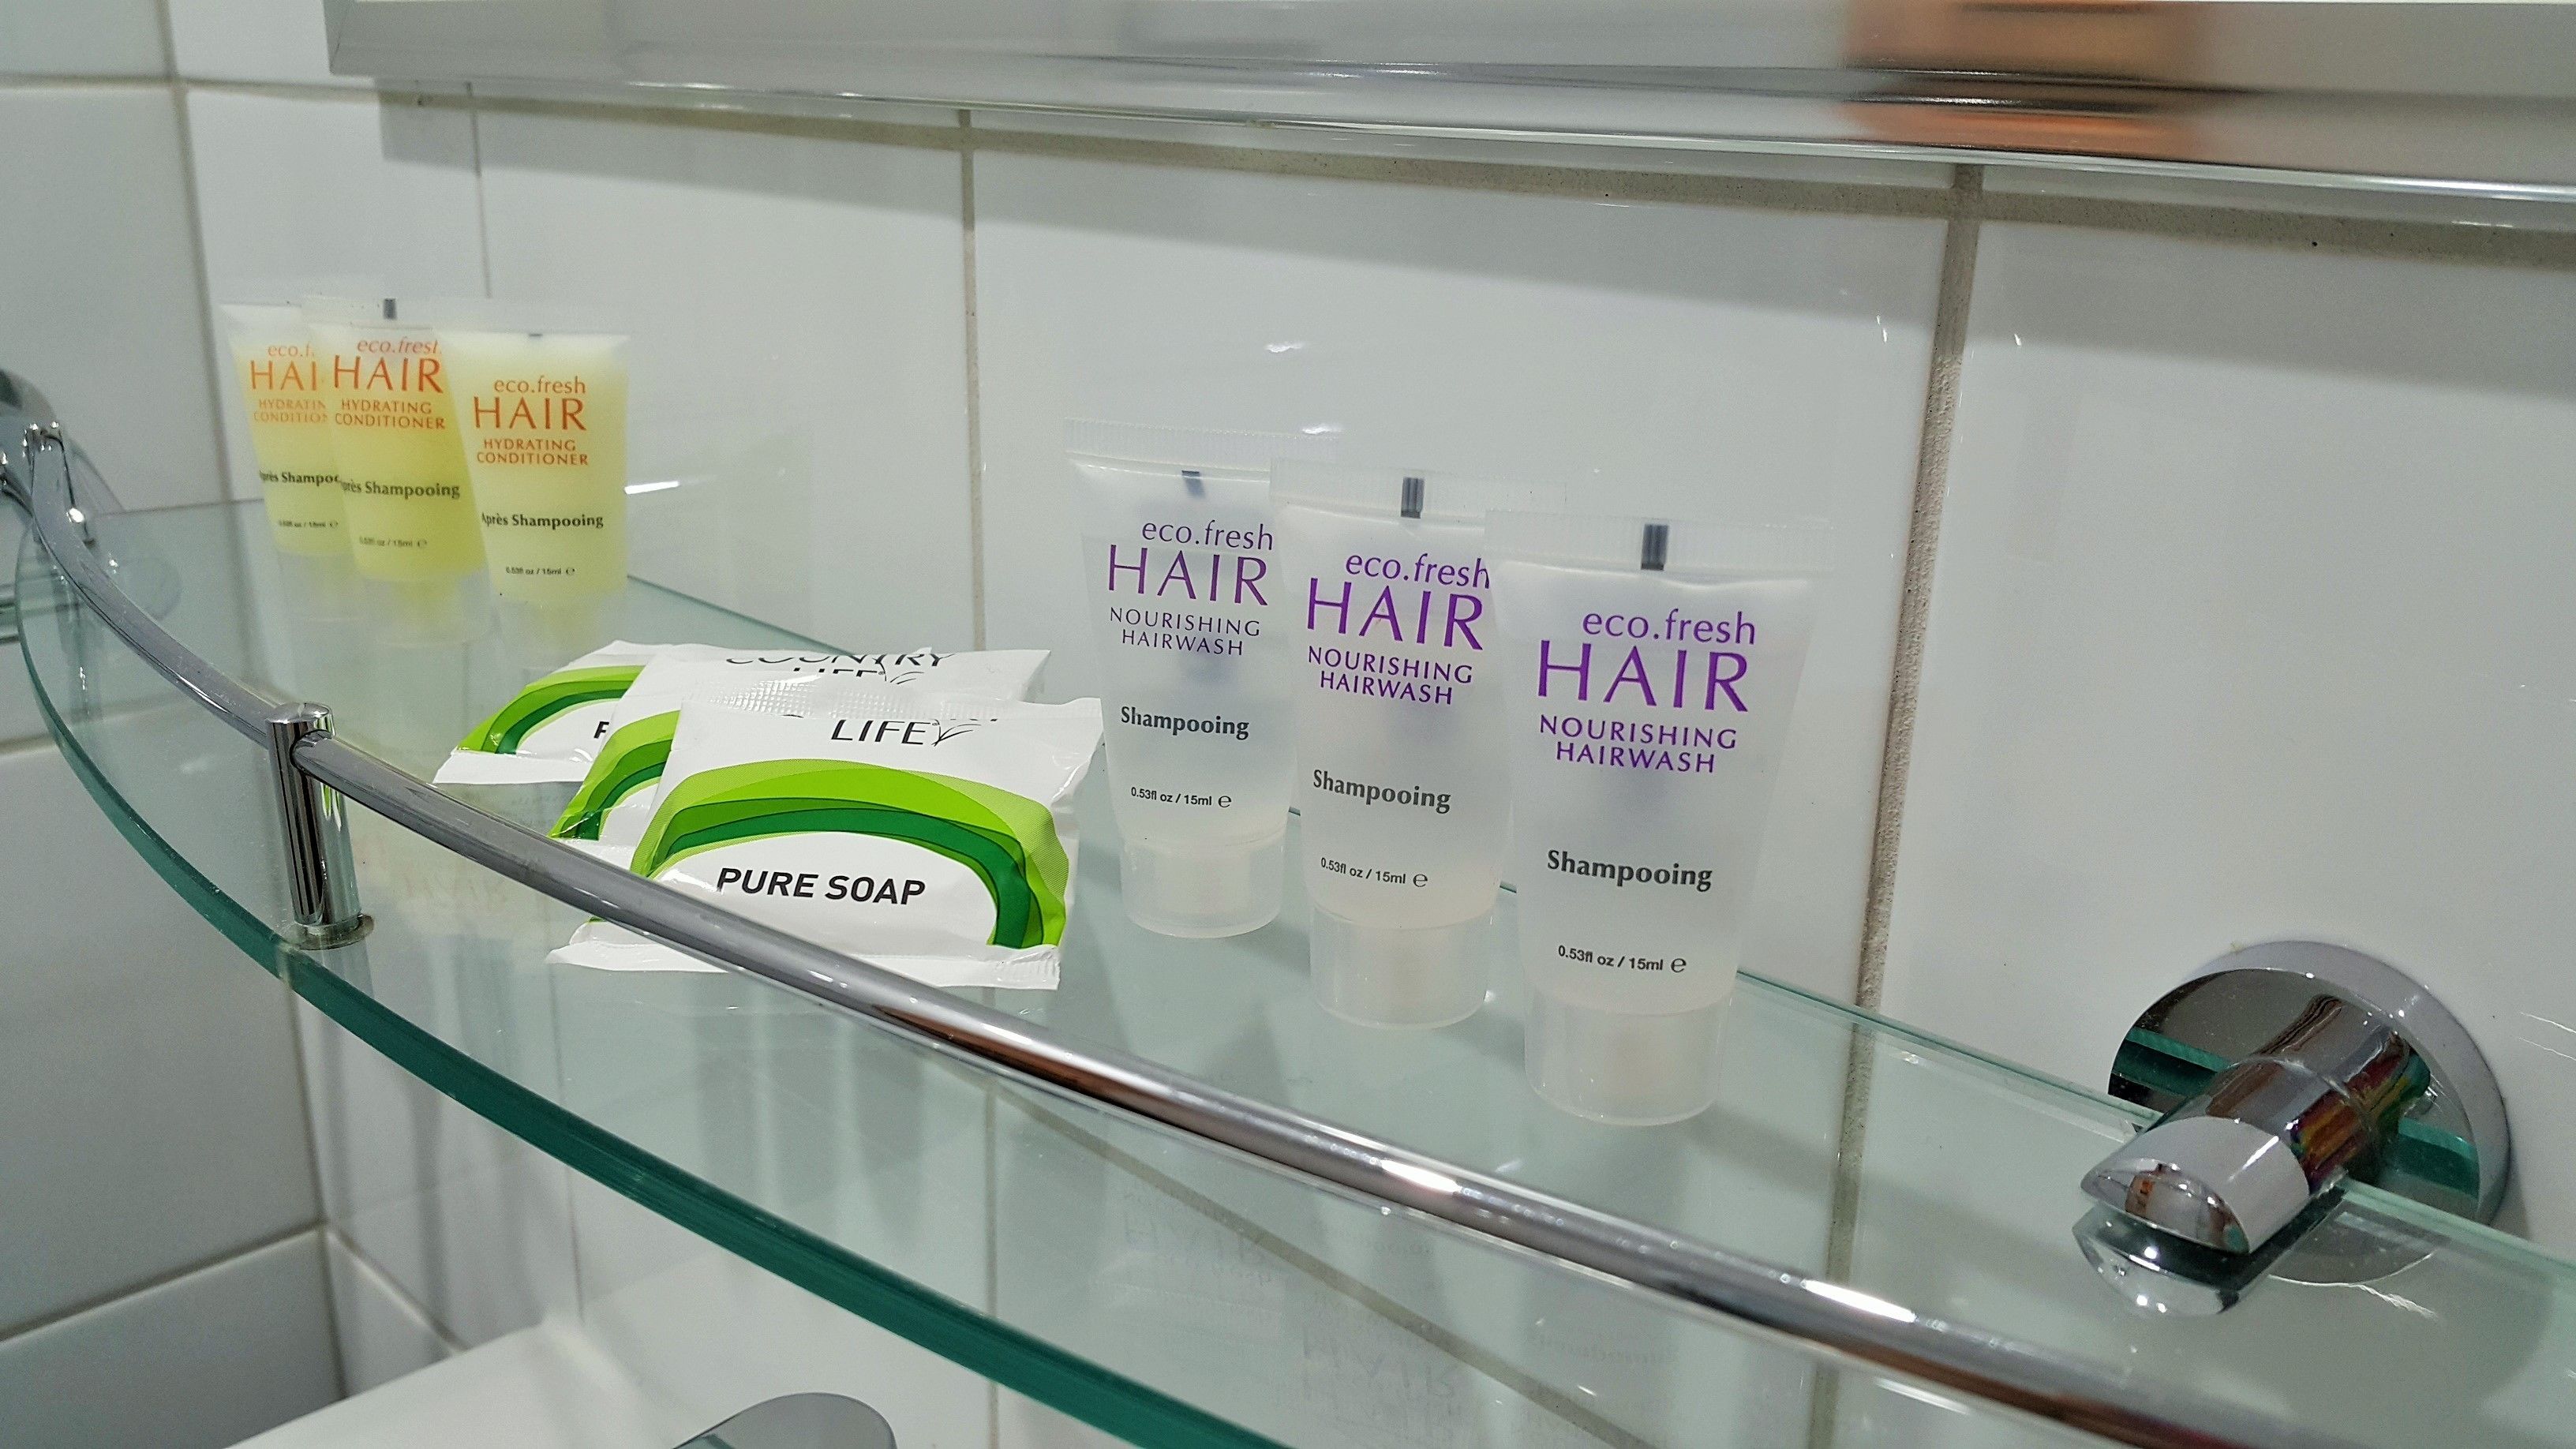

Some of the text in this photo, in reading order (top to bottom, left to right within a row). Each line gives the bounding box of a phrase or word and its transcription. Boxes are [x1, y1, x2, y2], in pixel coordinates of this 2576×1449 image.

[268, 341, 315, 357] eco.f
[250, 360, 317, 391] HAI
[334, 354, 444, 394] HAIR
[494, 375, 586, 394] eco.fresh
[253, 409, 328, 423] CONDITIO
[259, 399, 327, 410] HYDRATIN
[341, 398, 432, 414] HYDRATING
[474, 395, 586, 431] HAIR
[335, 413, 446, 429] CONDITIONER
[477, 451, 588, 466] CONDITIONER
[483, 438, 575, 451] HYDRATING
[281, 471, 340, 487] Shampo
[365, 480, 460, 500] Shampooing
[512, 514, 604, 530] Shampooing
[1142, 519, 1273, 551] eco.fresh
[1109, 544, 1267, 606] HAIR
[1345, 552, 1490, 590] eco.fresh
[1110, 606, 1260, 637] NOURISHING
[1307, 577, 1483, 651] HAIR
[1582, 608, 1756, 646] eco.fresh
[1122, 629, 1243, 656] HAIRWASH
[1309, 645, 1473, 684] NOURISHING
[1537, 639, 1749, 713] HAIR
[1320, 670, 1452, 705] HAIRWASH
[830, 719, 932, 745] LIFE
[1121, 706, 1250, 740] Shampooing
[1540, 714, 1737, 750] NOURISHING
[1556, 741, 1715, 773] HAIRWASH
[1131, 786, 1157, 800] 0.53fl
[1159, 793, 1173, 803] oz
[1175, 793, 1181, 803] /
[1184, 795, 1212, 806] 15ml
[1313, 769, 1451, 814] Shampooing
[716, 867, 926, 905] PURE SOAP
[1320, 857, 1346, 874] 0.53fl
[1350, 868, 1363, 878] oz
[1365, 868, 1372, 879] /
[1375, 871, 1406, 884] 15ml
[1547, 849, 1713, 893] Shampooing
[1558, 945, 1593, 963] 0.53fl
[1597, 956, 1615, 967] oz
[1617, 956, 1625, 968] /
[1629, 957, 1664, 971] 15ml
